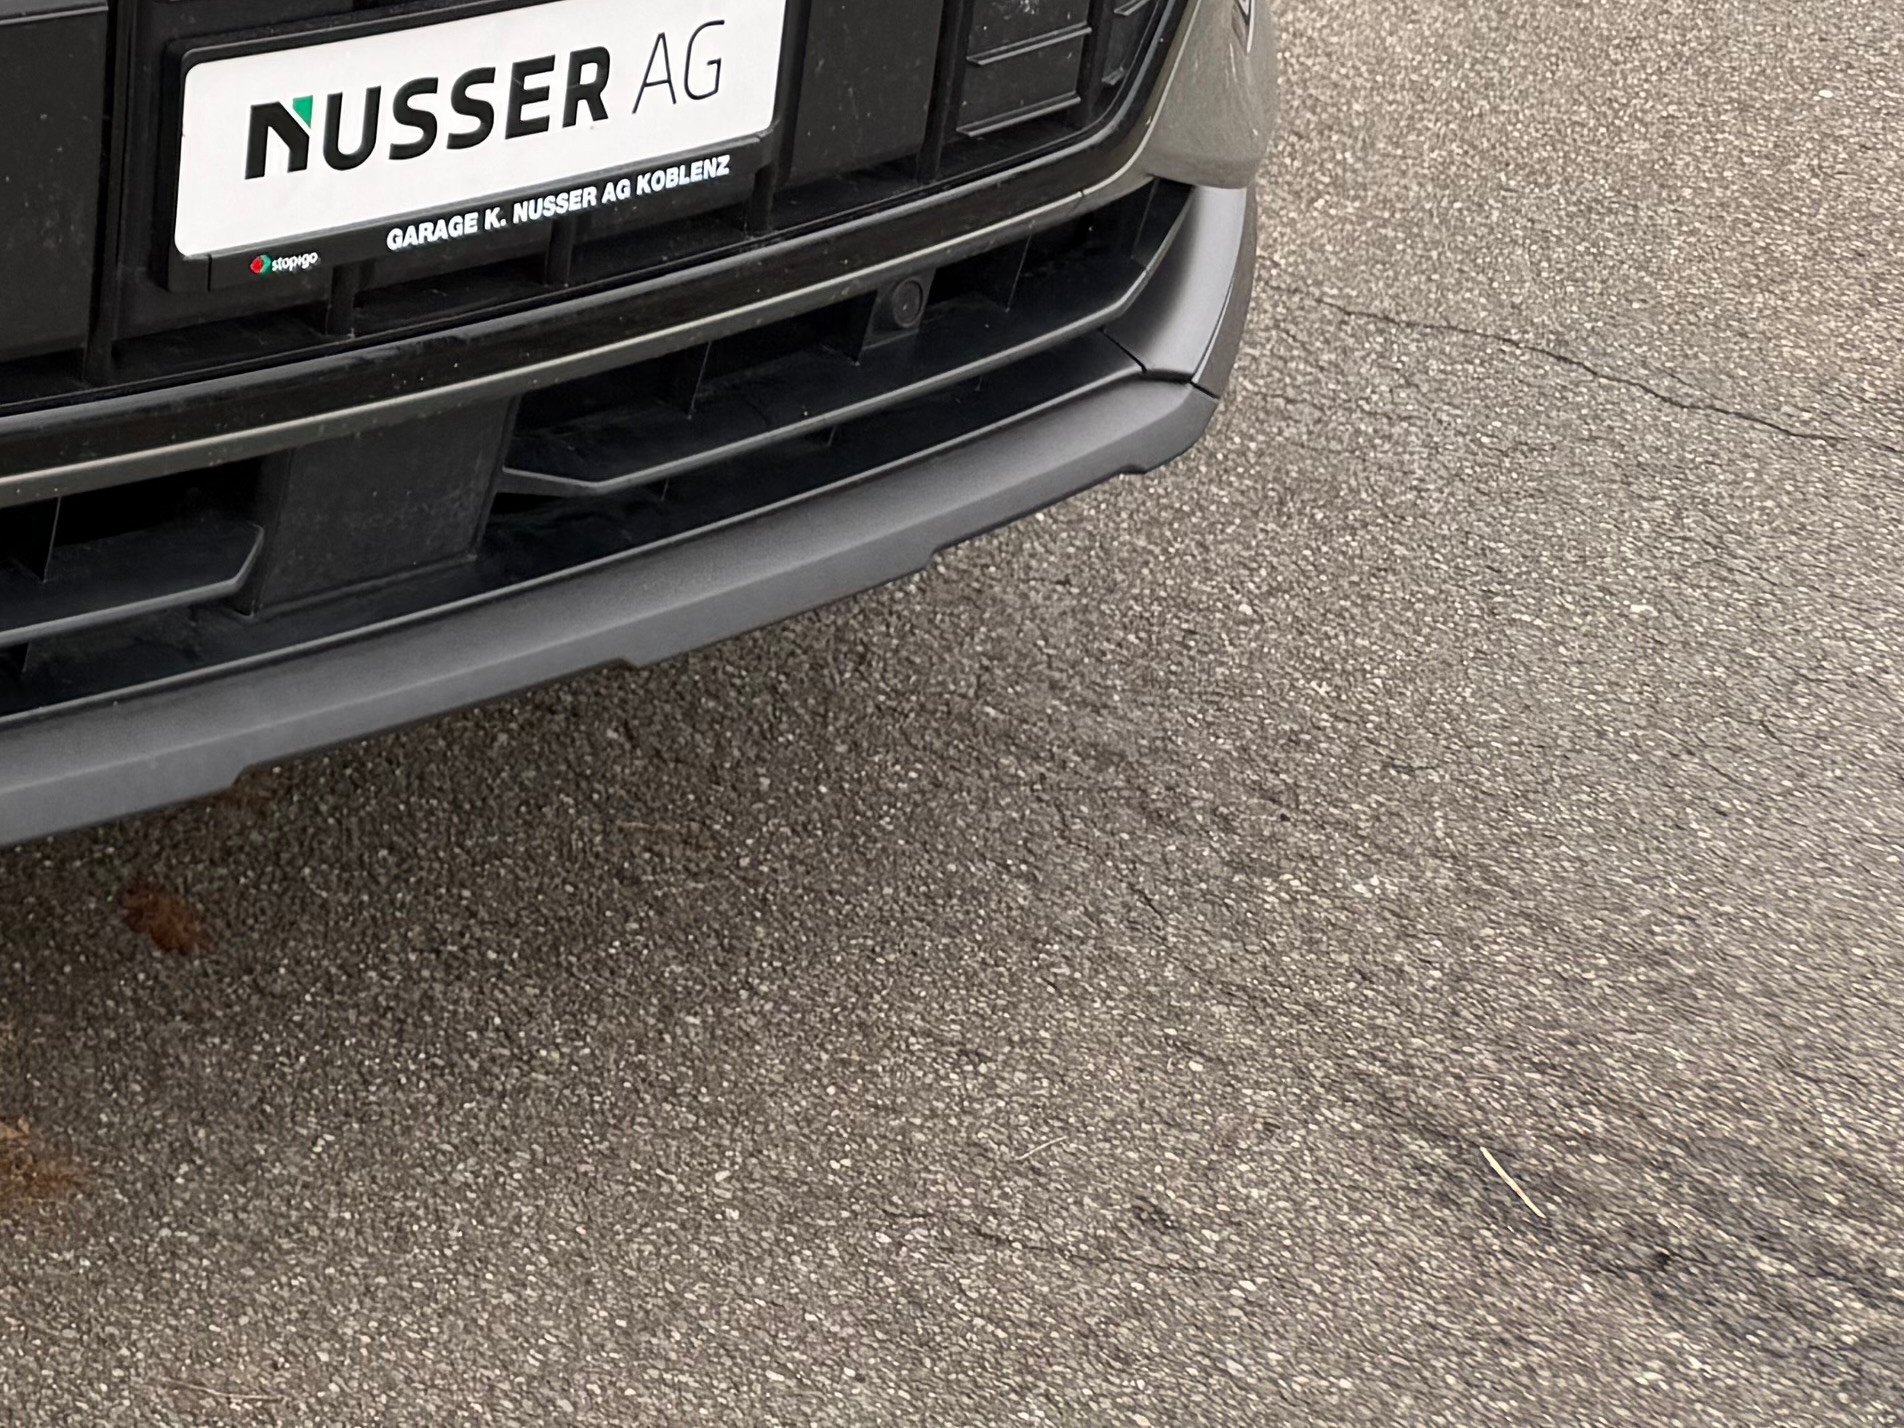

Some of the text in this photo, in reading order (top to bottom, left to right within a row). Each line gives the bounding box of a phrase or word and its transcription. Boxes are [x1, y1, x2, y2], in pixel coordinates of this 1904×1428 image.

[244, 20, 725, 179] NUSSER AG
[386, 154, 731, 251] GARAGE K. NUSSER AG KOBLENZ
